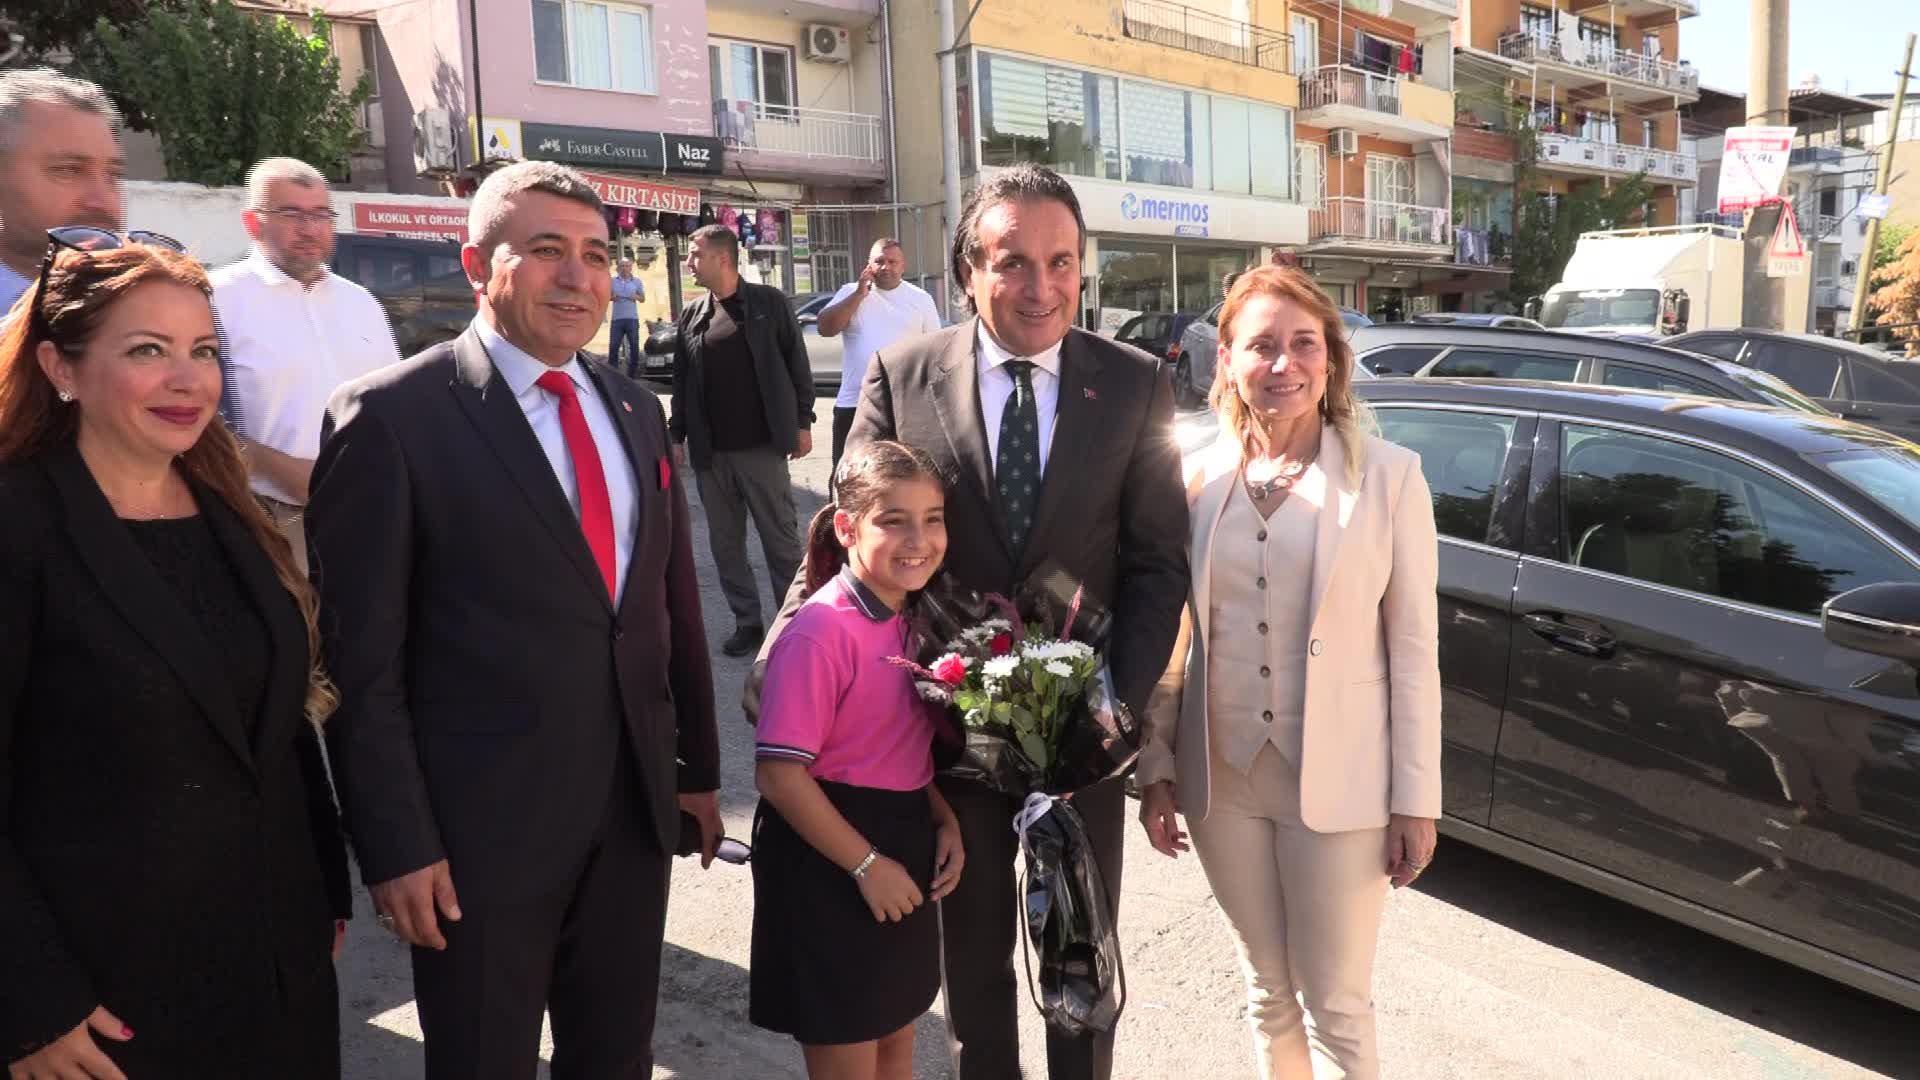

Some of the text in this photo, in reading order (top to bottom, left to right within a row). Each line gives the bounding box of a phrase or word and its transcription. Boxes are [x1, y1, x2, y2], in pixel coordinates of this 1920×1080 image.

[678, 143, 710, 160] Naz
[607, 184, 698, 212] KIRTASİYE
[368, 211, 469, 226] İLKOKUL VE ORTAOK
[1142, 199, 1208, 223] merinos
